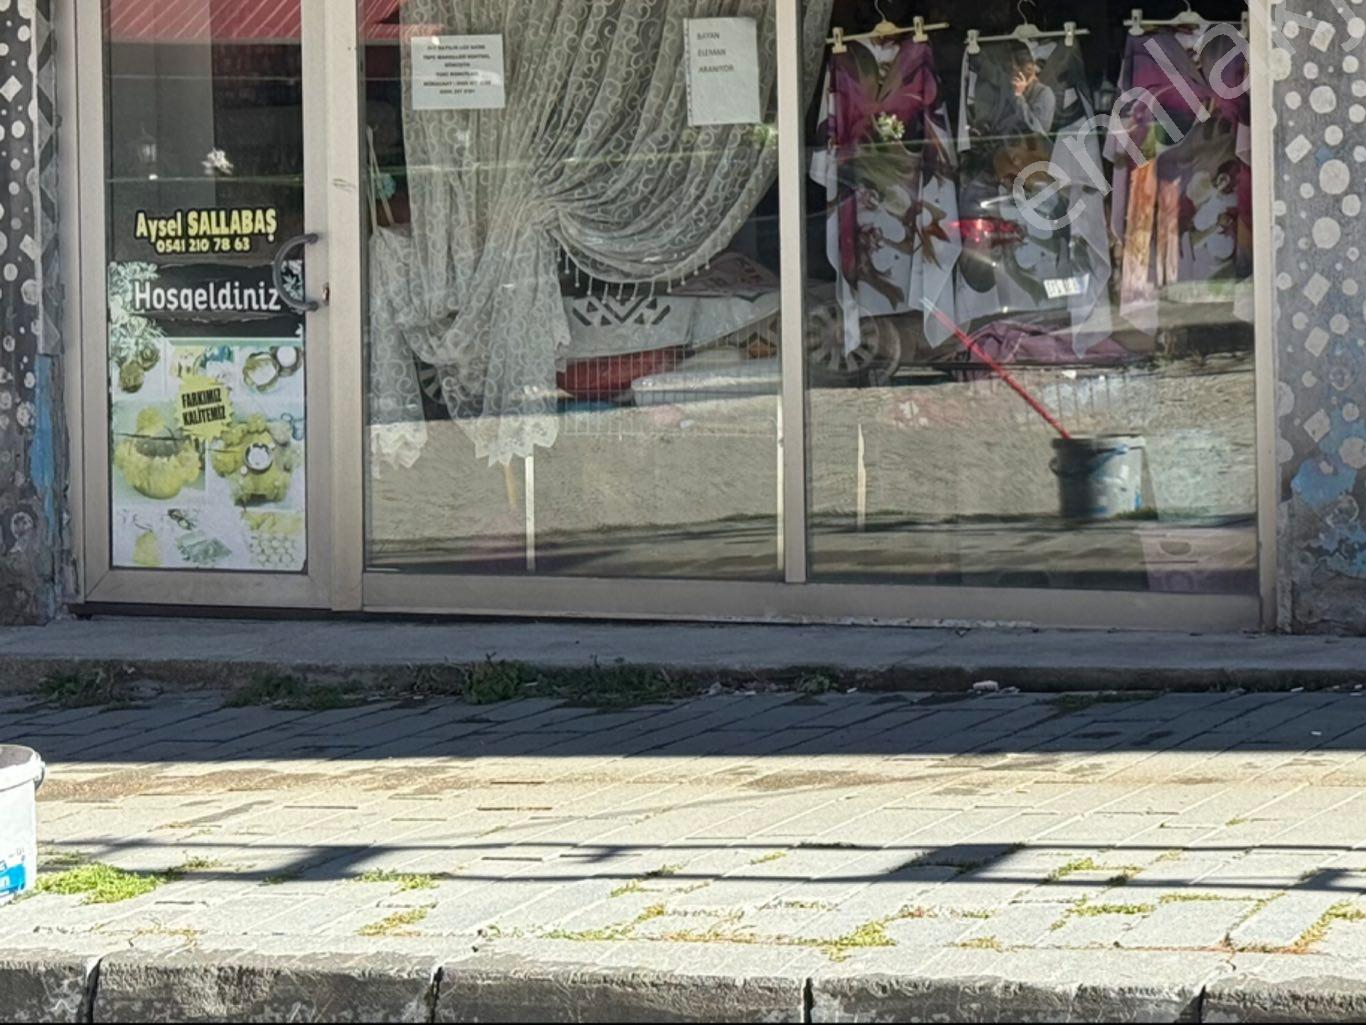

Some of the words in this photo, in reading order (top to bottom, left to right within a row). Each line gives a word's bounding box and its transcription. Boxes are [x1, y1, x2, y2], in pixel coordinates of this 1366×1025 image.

[135, 211, 182, 243] Aysel
[187, 209, 278, 242] SALLABAŞ
[156, 238, 185, 254] 0541
[189, 237, 210, 253] 210
[214, 237, 231, 252] 78
[234, 236, 250, 252] 63
